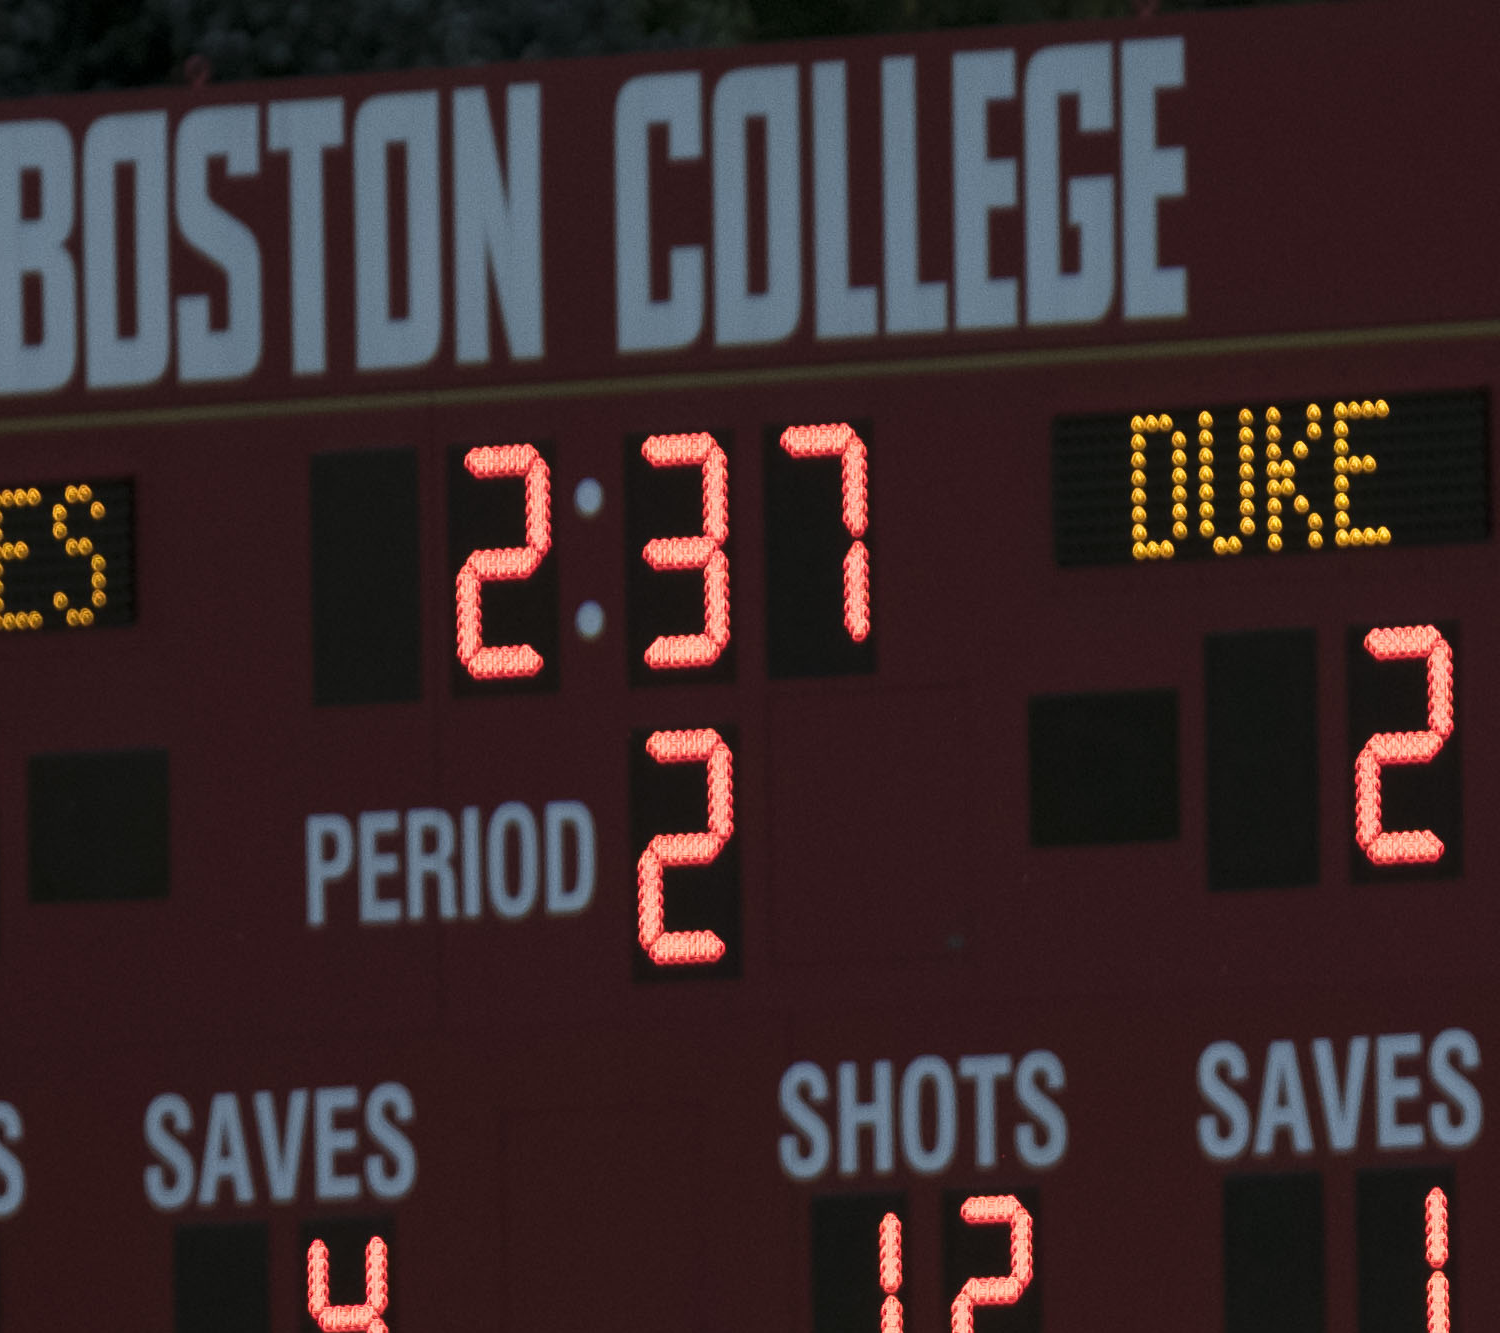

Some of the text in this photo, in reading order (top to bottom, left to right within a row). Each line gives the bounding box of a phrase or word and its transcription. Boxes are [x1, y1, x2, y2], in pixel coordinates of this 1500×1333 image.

[613, 36, 1188, 354] COLLEGE
[455, 422, 871, 681] 2:37
[1129, 398, 1393, 561] DUKE
[1354, 623, 1455, 865] 2
[305, 800, 597, 928] PERIOD
[636, 727, 735, 966] 2
[143, 1081, 418, 1211] SAVES
[778, 1049, 1069, 1181] SHOTS
[1196, 1027, 1484, 1161] SAVES
